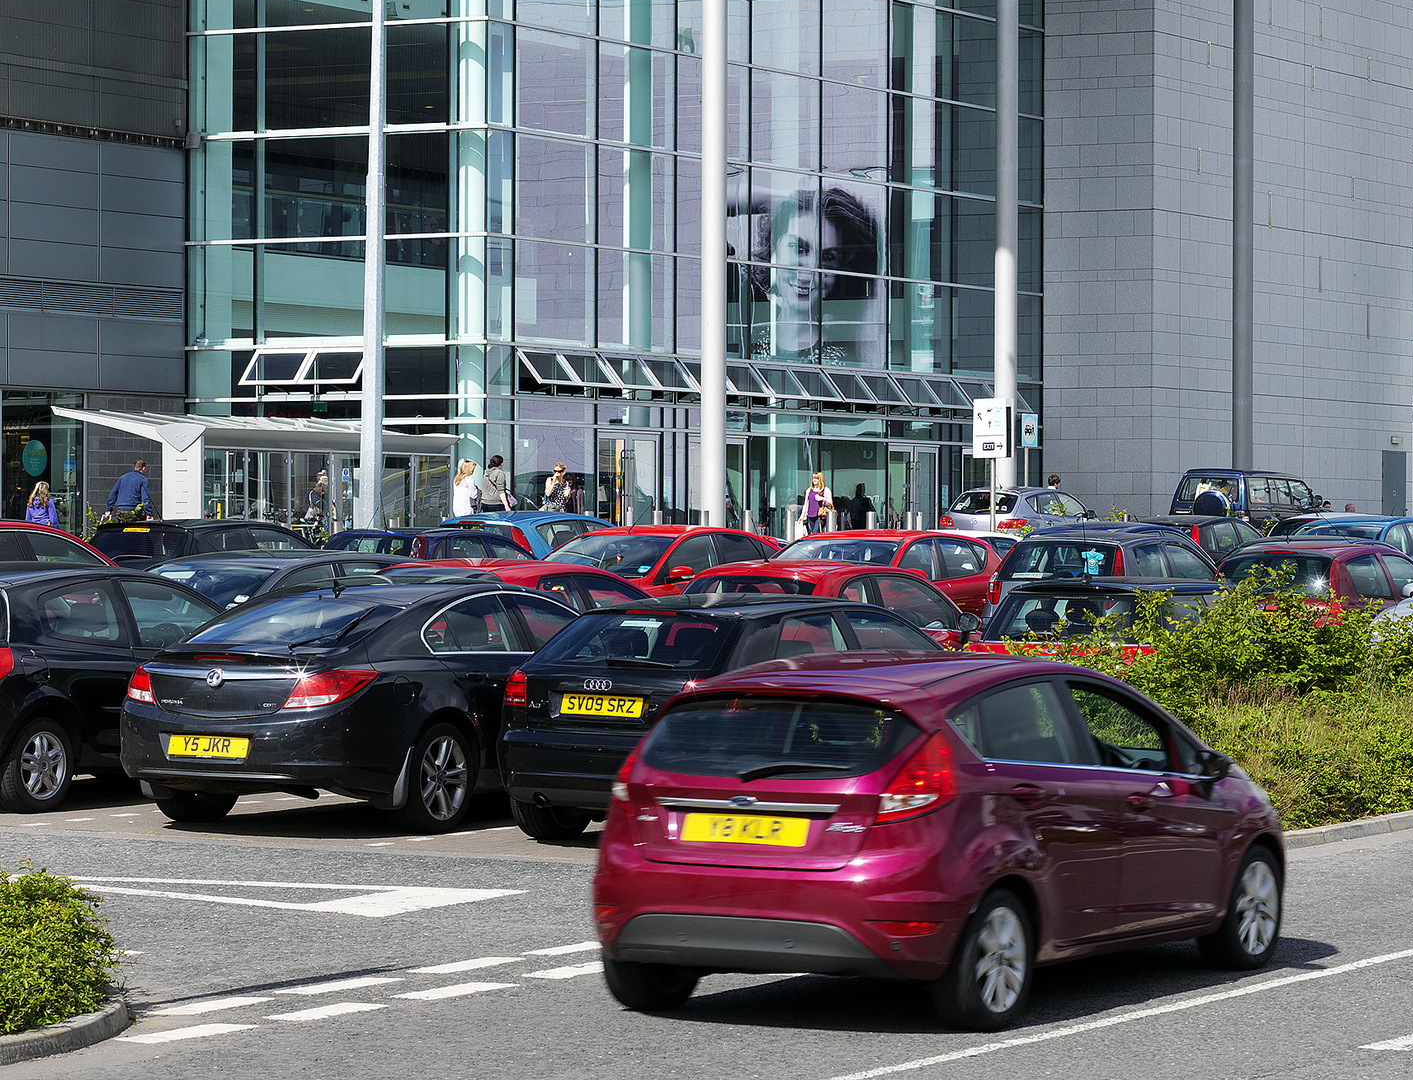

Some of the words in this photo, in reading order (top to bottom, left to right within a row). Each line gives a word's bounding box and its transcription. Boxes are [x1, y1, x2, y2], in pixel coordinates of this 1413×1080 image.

[567, 696, 604, 711] SV09
[607, 698, 637, 713] SRZ
[183, 737, 199, 751] Y5
[203, 738, 231, 753] JKR
